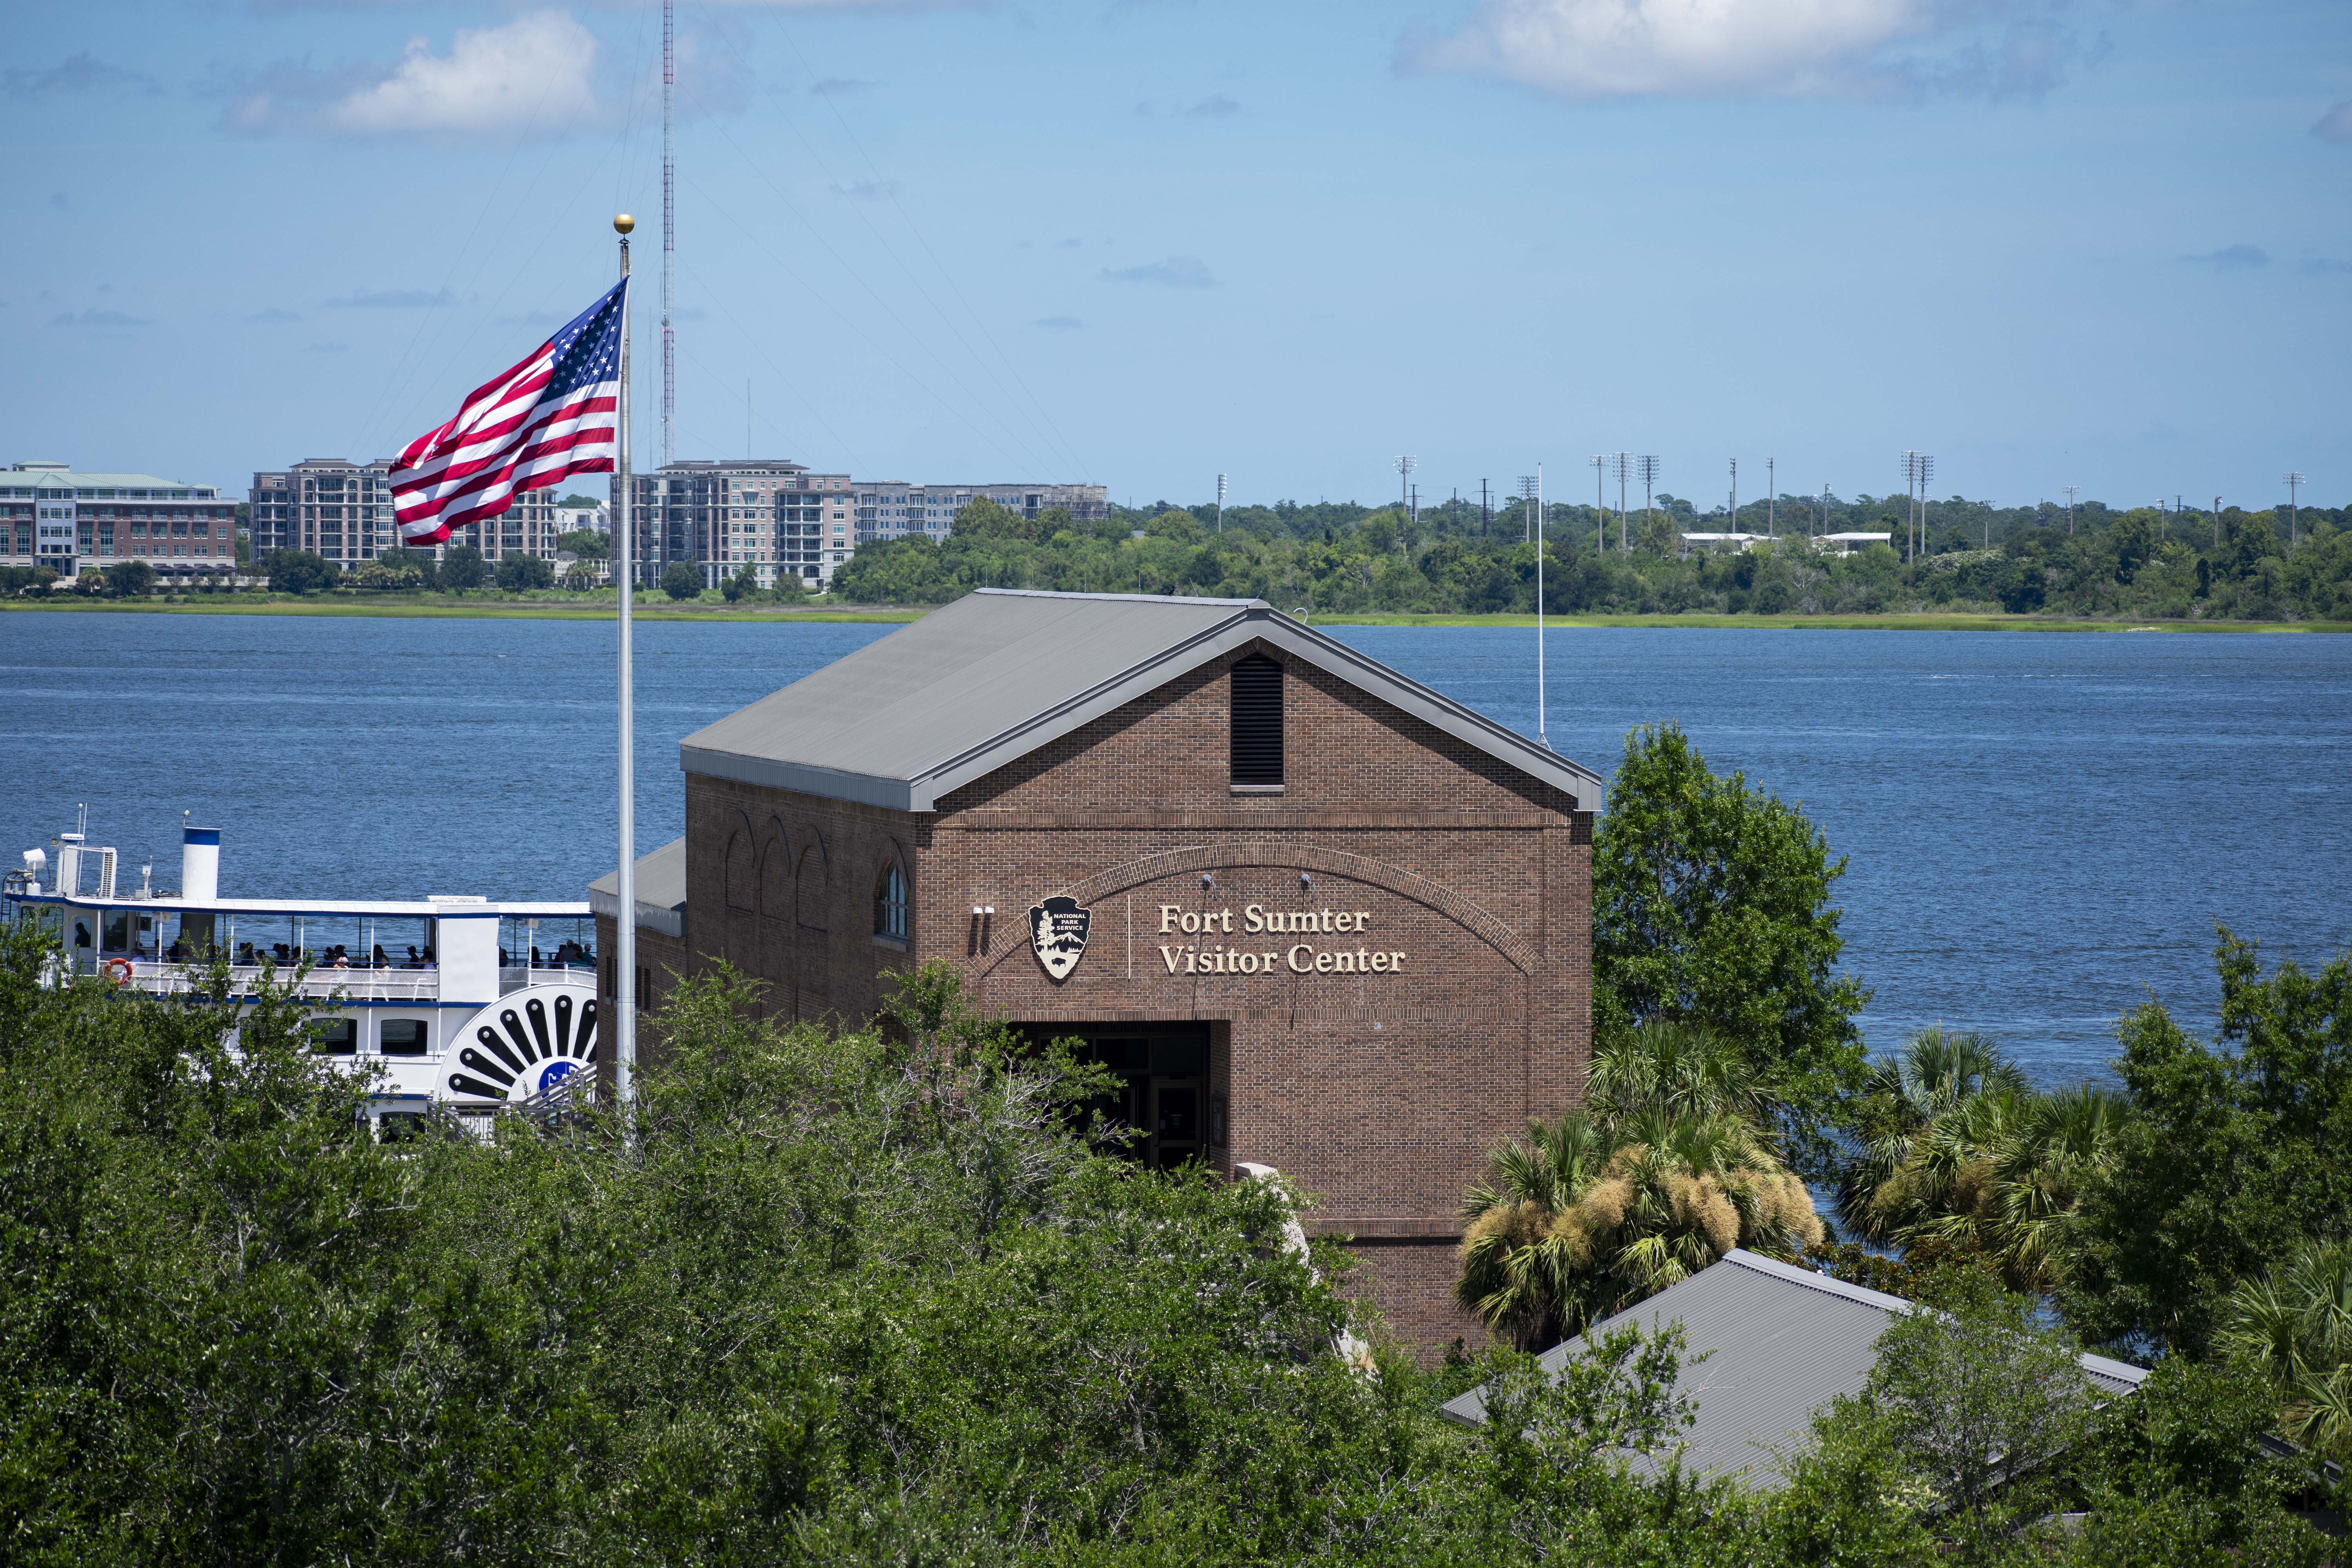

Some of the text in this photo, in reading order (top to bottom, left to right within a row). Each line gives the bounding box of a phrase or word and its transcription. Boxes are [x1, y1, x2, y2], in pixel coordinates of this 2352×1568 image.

[1158, 904, 1370, 933] Fort Sumter
[1158, 944, 1406, 973] Visitor Center
